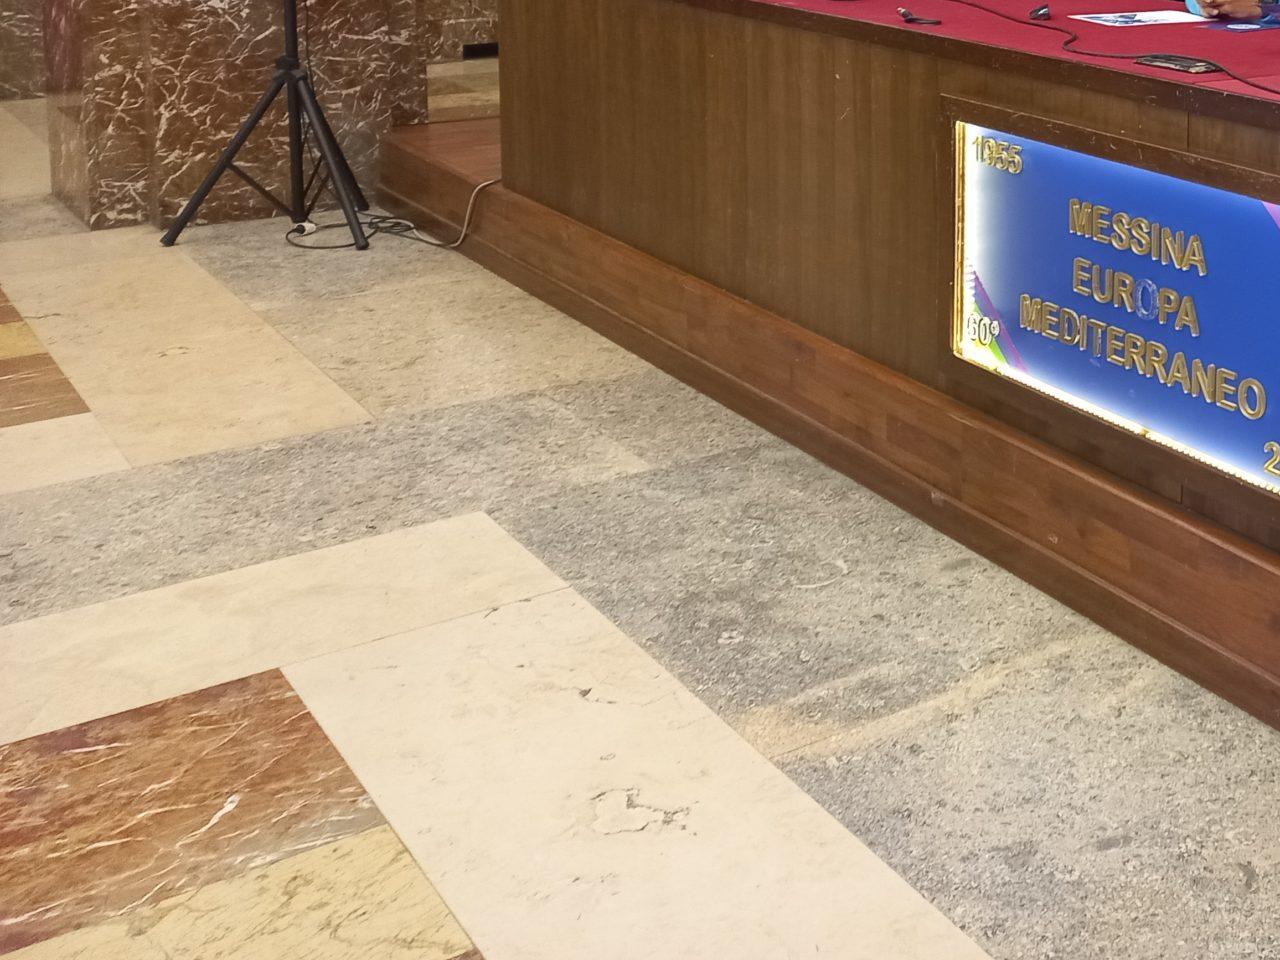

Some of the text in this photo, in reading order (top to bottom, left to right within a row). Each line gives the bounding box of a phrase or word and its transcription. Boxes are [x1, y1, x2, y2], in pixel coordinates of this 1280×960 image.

[972, 135, 1023, 174] 1955
[1068, 198, 1208, 276] MESSINA
[1073, 257, 1200, 337] EUROPA
[1019, 294, 1267, 420] MEDITERRANEO
